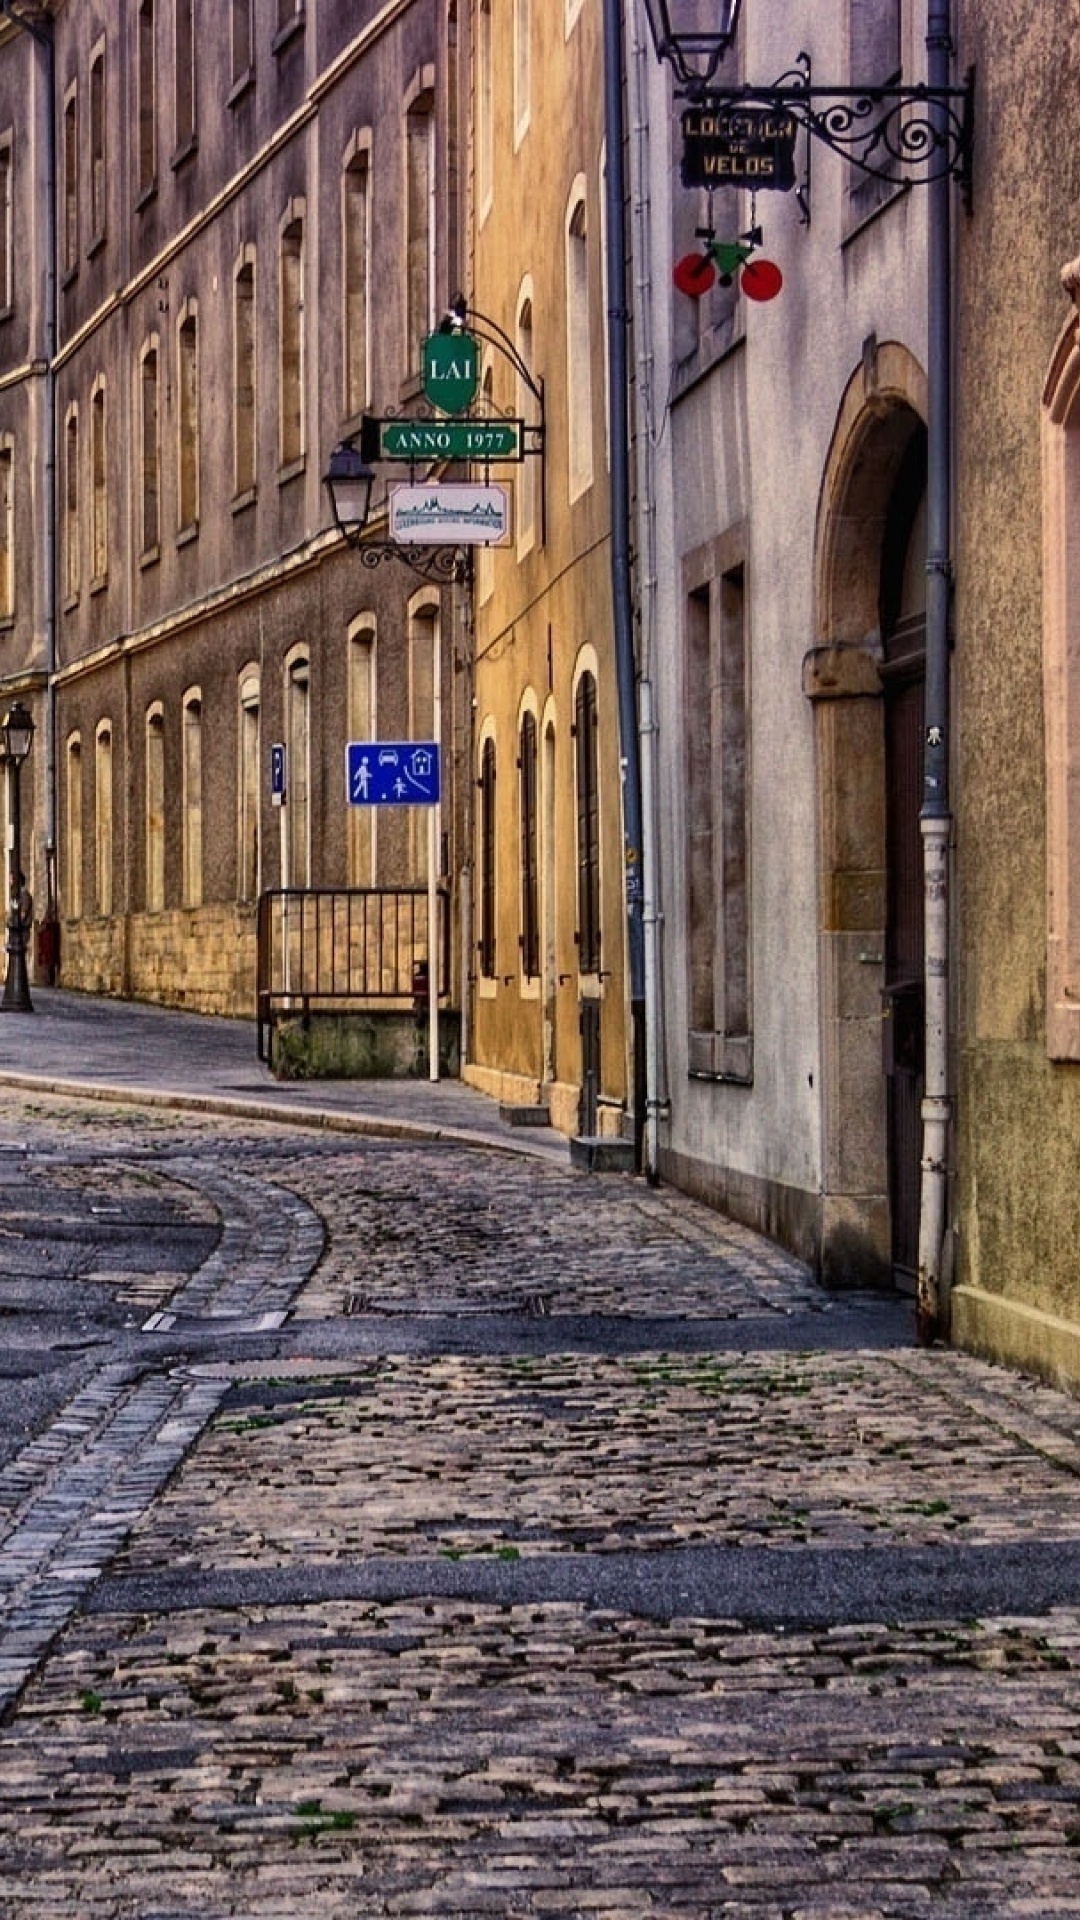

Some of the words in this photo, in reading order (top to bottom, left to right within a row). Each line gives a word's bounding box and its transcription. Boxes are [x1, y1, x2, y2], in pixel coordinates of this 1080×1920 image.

[704, 155, 773, 175] VELOS
[430, 360, 471, 380] LAI
[395, 432, 451, 449] ANNO
[466, 433, 504, 449] 1977
